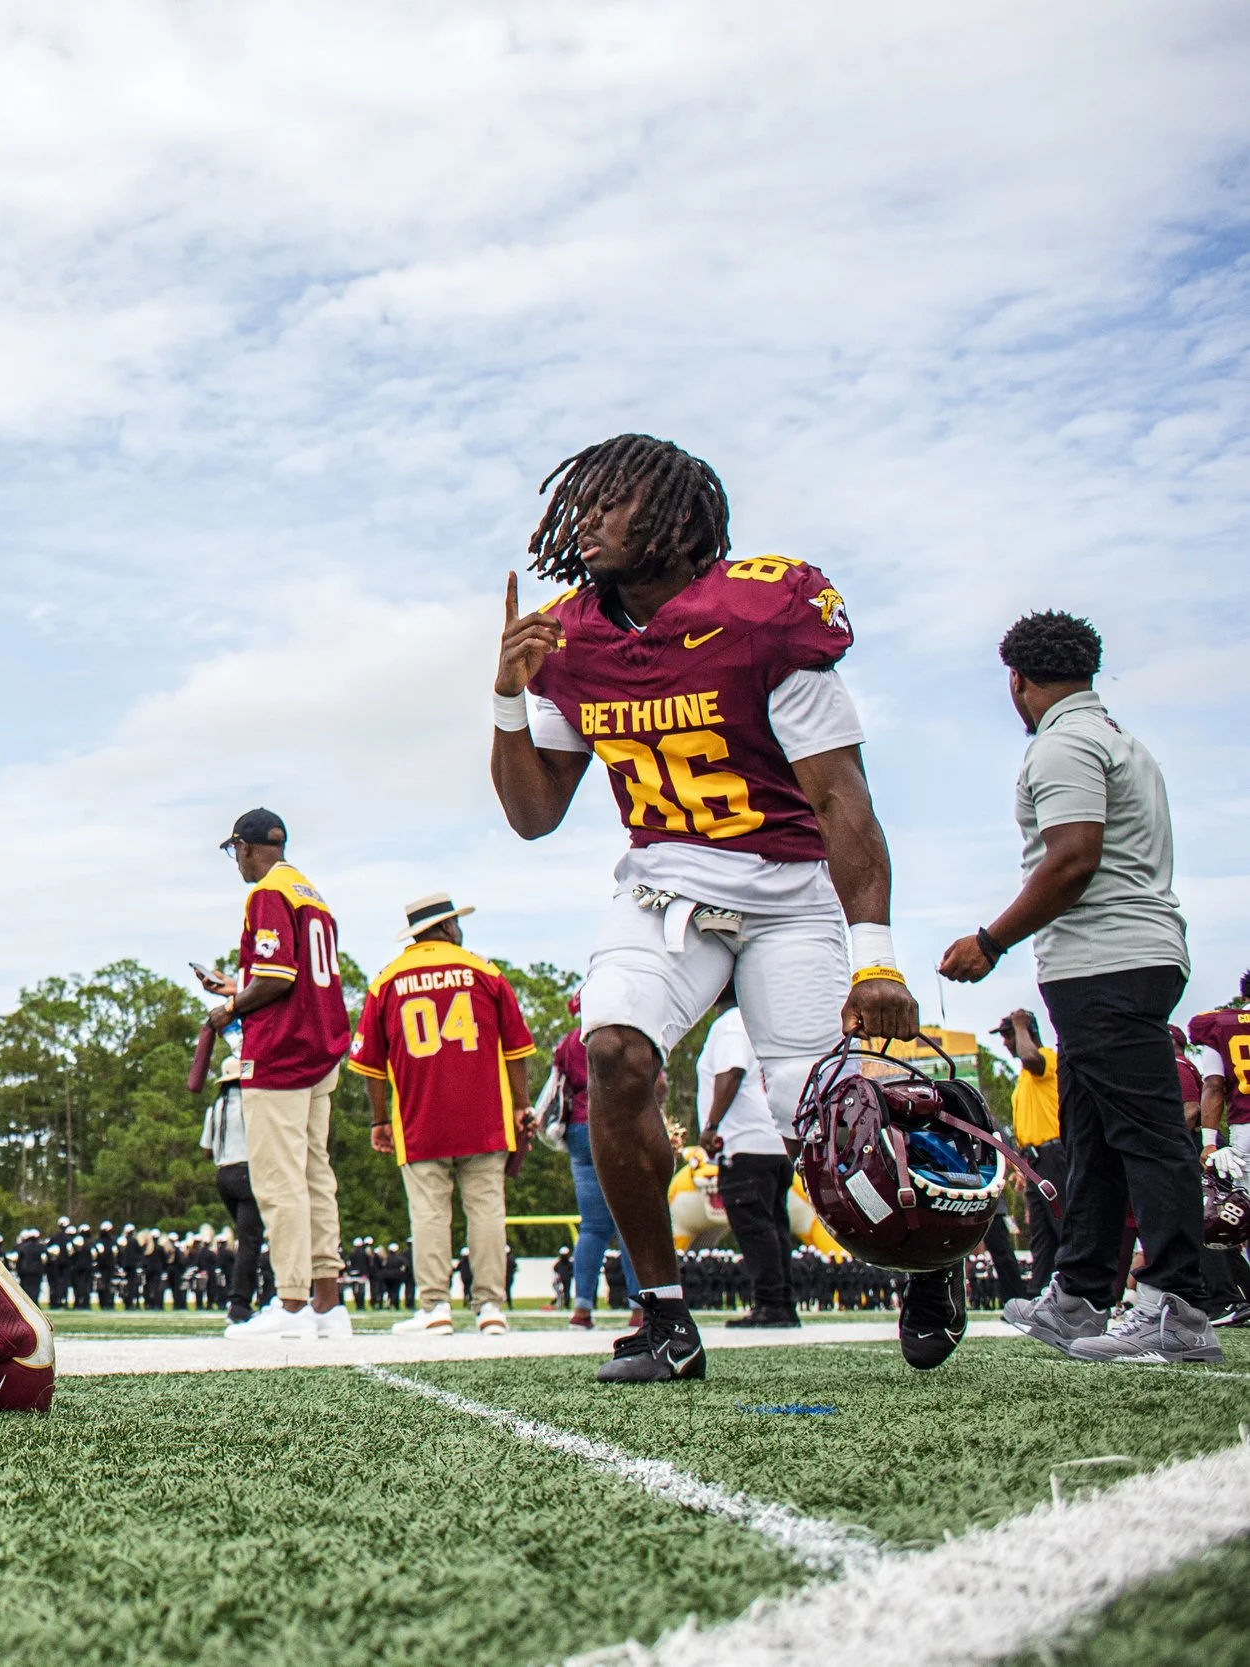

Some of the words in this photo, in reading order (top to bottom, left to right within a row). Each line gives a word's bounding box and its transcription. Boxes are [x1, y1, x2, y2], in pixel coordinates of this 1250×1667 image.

[579, 690, 725, 735] BETHUNE
[594, 729, 766, 840] 86
[394, 968, 475, 997] WILDCATS
[400, 990, 480, 1059] 04
[1220, 1202, 1244, 1226] 88
